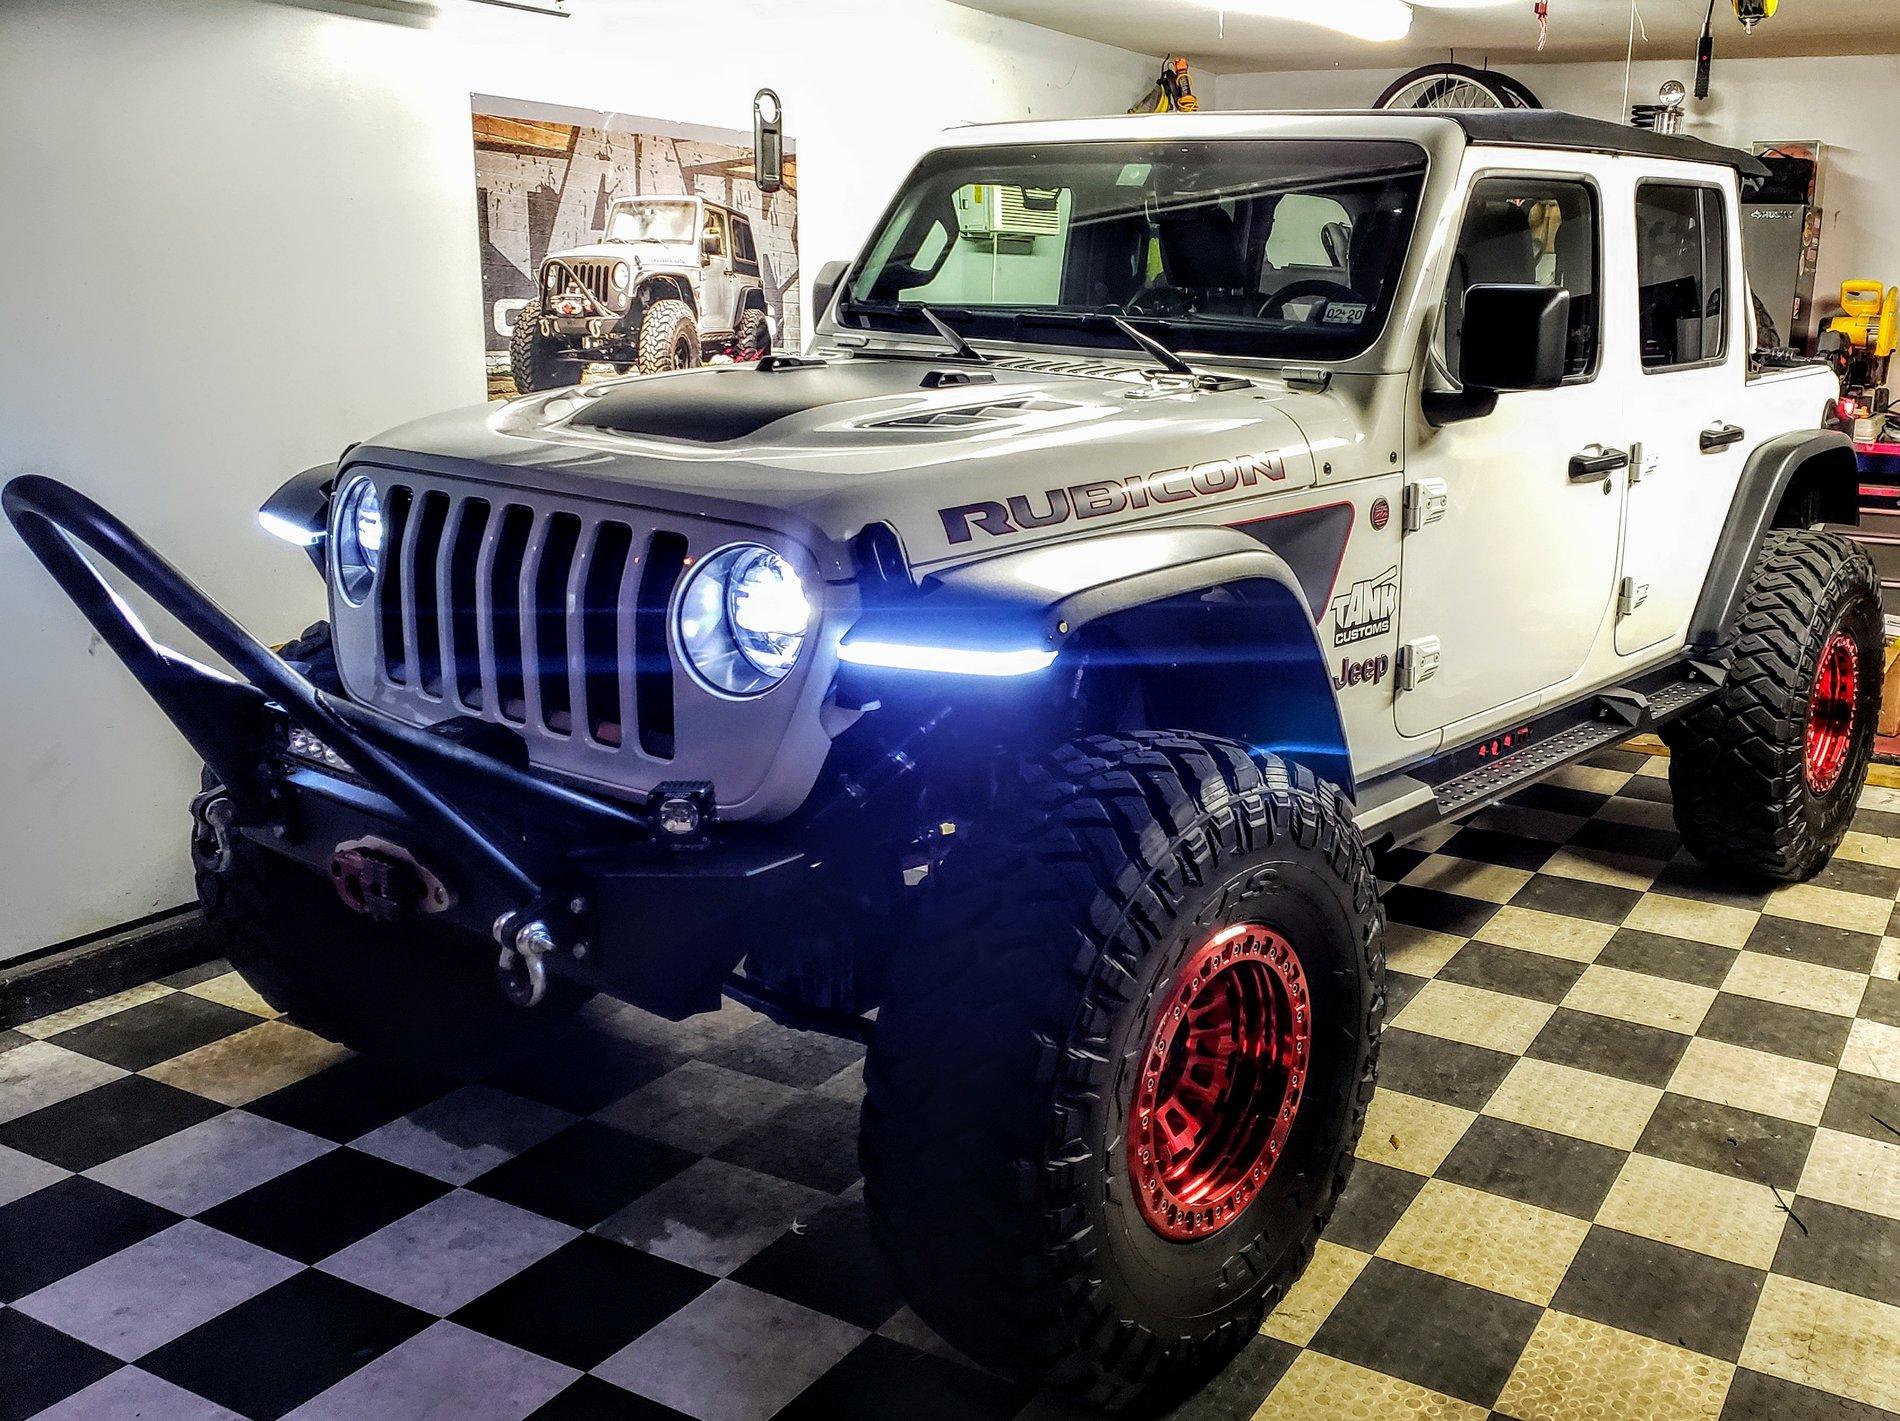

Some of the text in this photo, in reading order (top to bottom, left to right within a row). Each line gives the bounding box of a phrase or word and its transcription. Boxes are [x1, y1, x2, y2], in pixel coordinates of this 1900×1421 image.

[1326, 308, 1363, 320] 02 20
[938, 449, 1286, 545] RUBICON
[1330, 565, 1397, 629] TANK
[1334, 619, 1390, 645] CUSTOMS
[1332, 653, 1389, 691] Jeep
